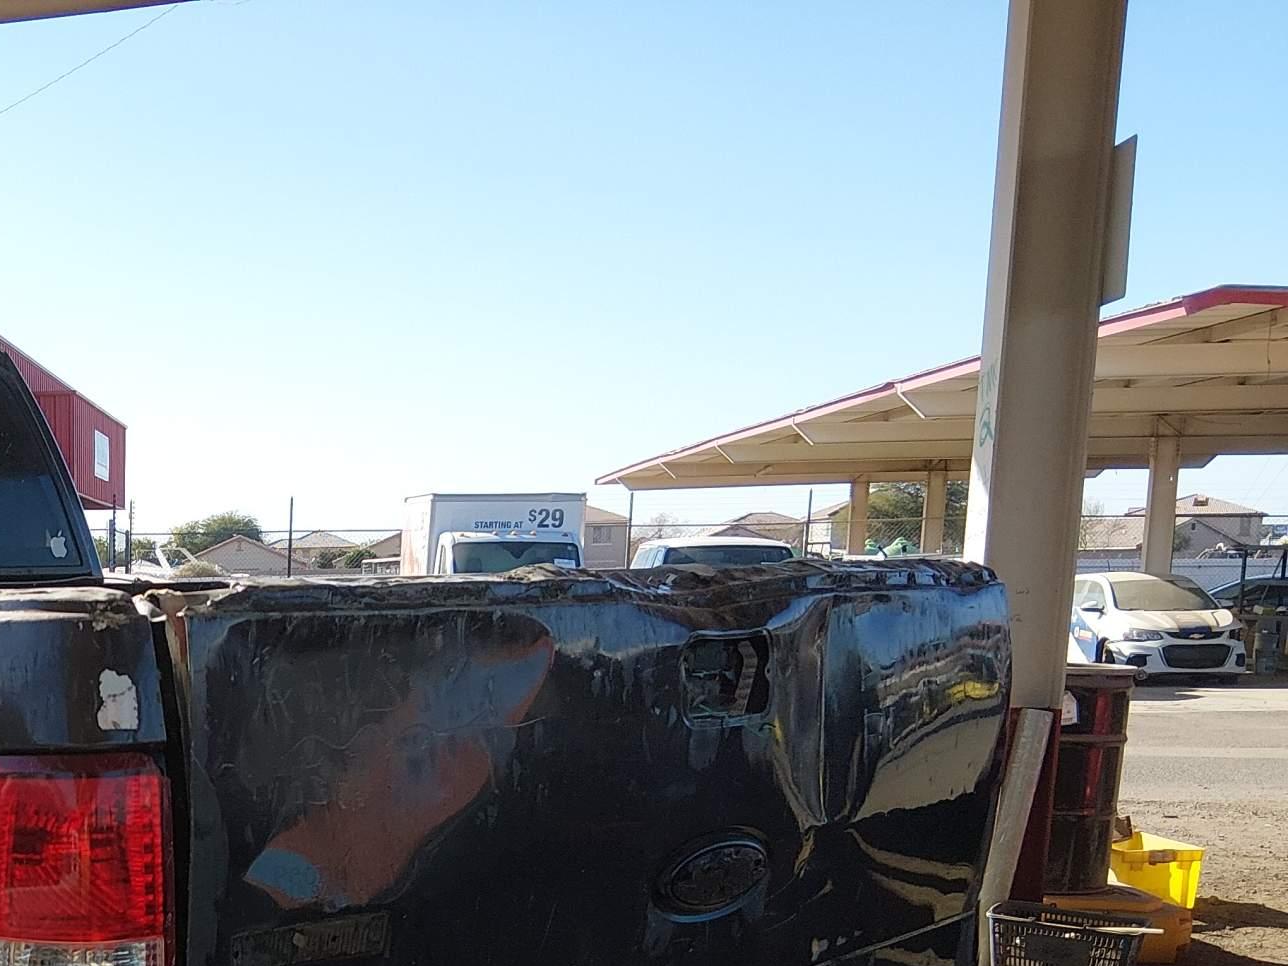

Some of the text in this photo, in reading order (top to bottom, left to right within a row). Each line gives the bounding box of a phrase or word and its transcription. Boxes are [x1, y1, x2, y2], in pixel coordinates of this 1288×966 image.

[474, 508, 564, 529] STARTING AT $29
